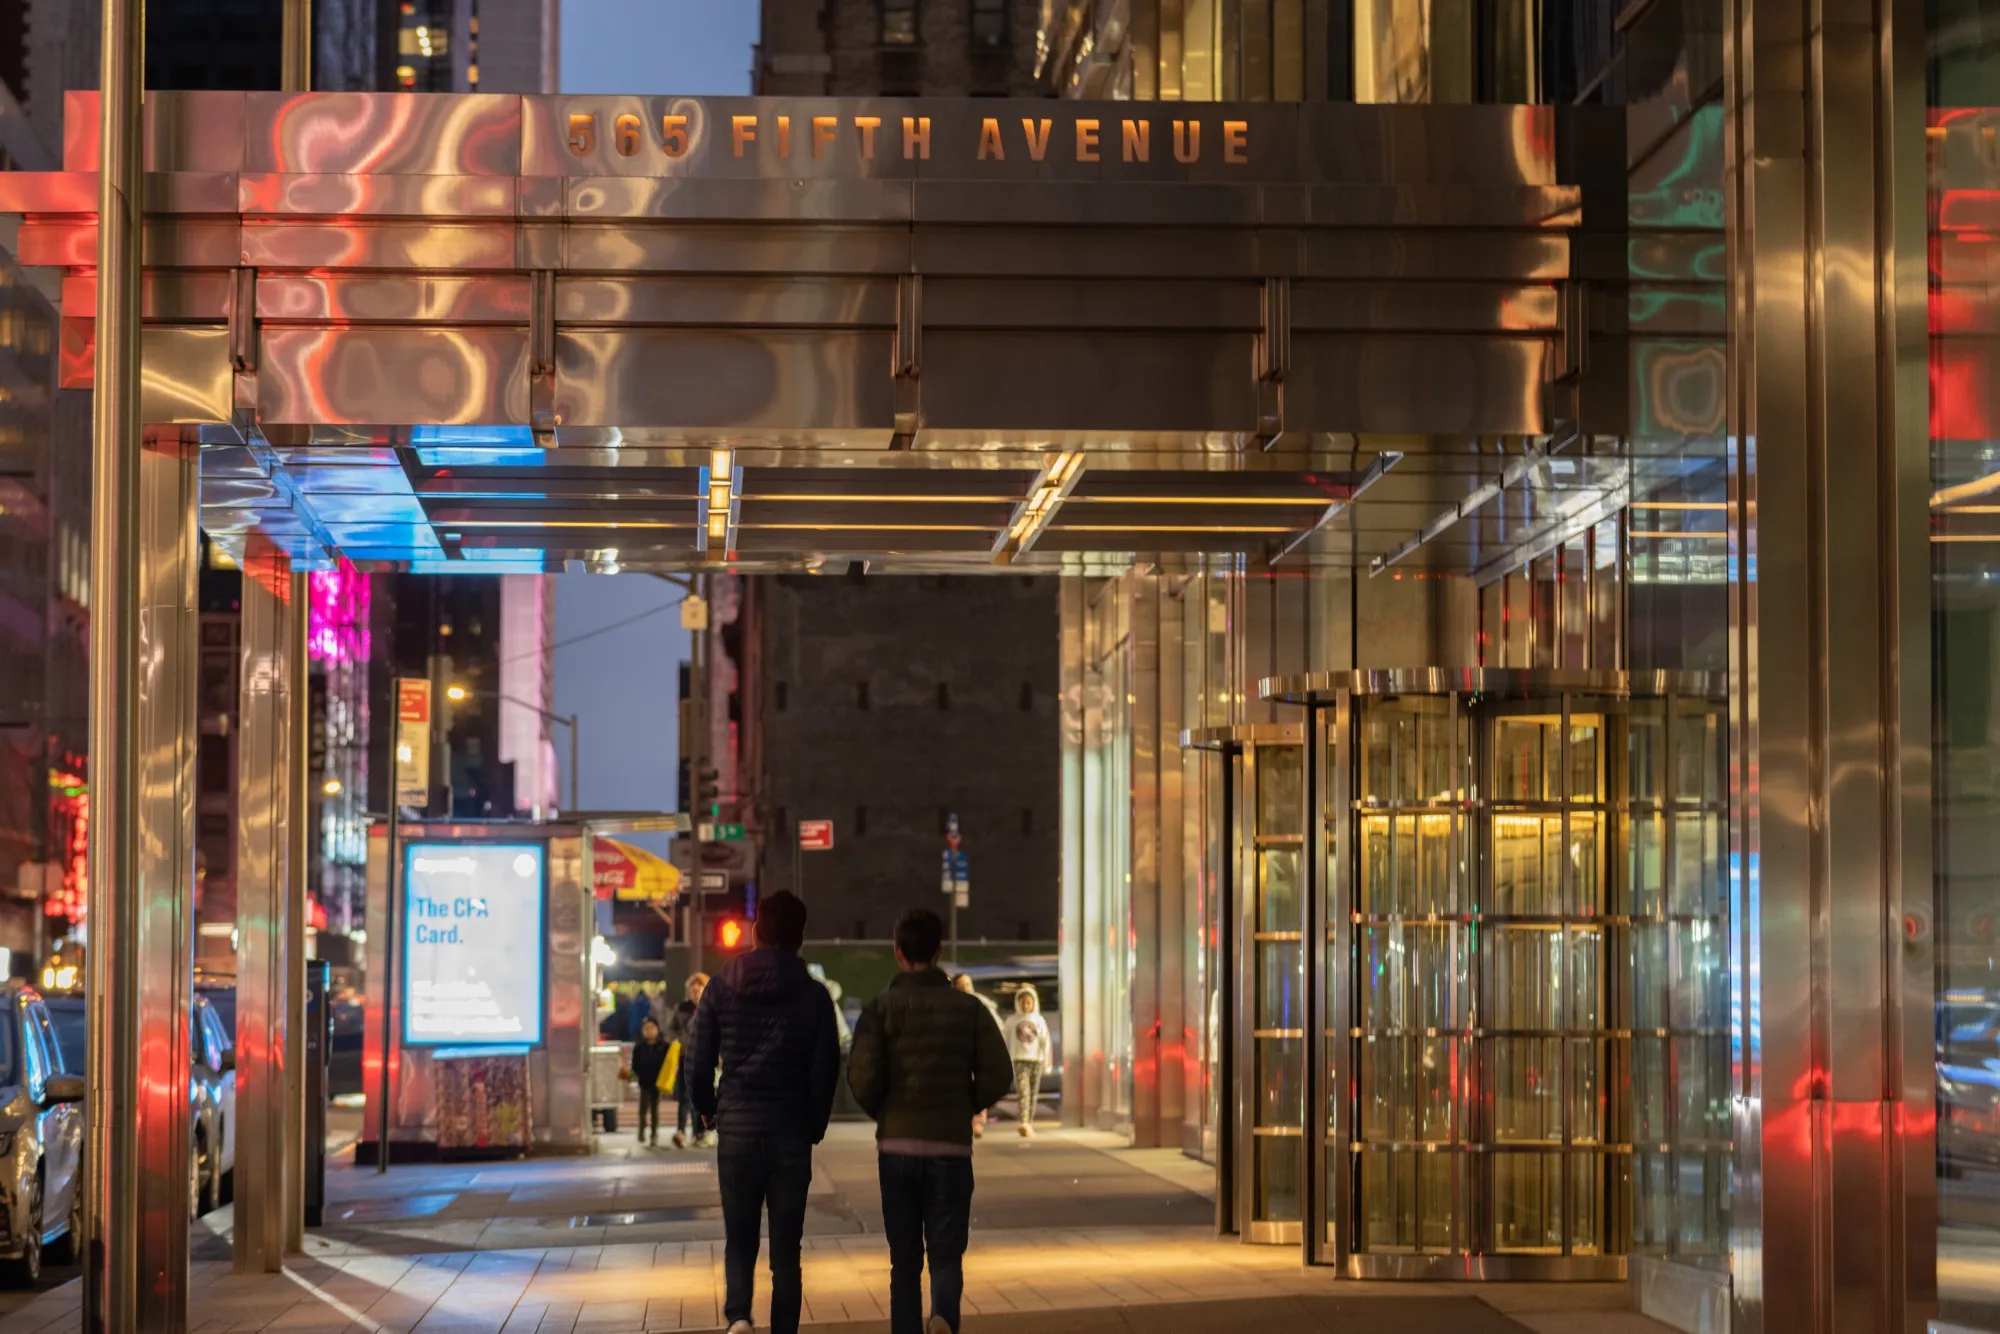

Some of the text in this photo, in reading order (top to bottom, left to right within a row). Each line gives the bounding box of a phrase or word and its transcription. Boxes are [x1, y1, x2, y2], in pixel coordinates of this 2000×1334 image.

[568, 114, 1248, 164] 565 FIFTH AVENUE
[416, 897, 449, 917] The
[416, 924, 464, 944] Card.
